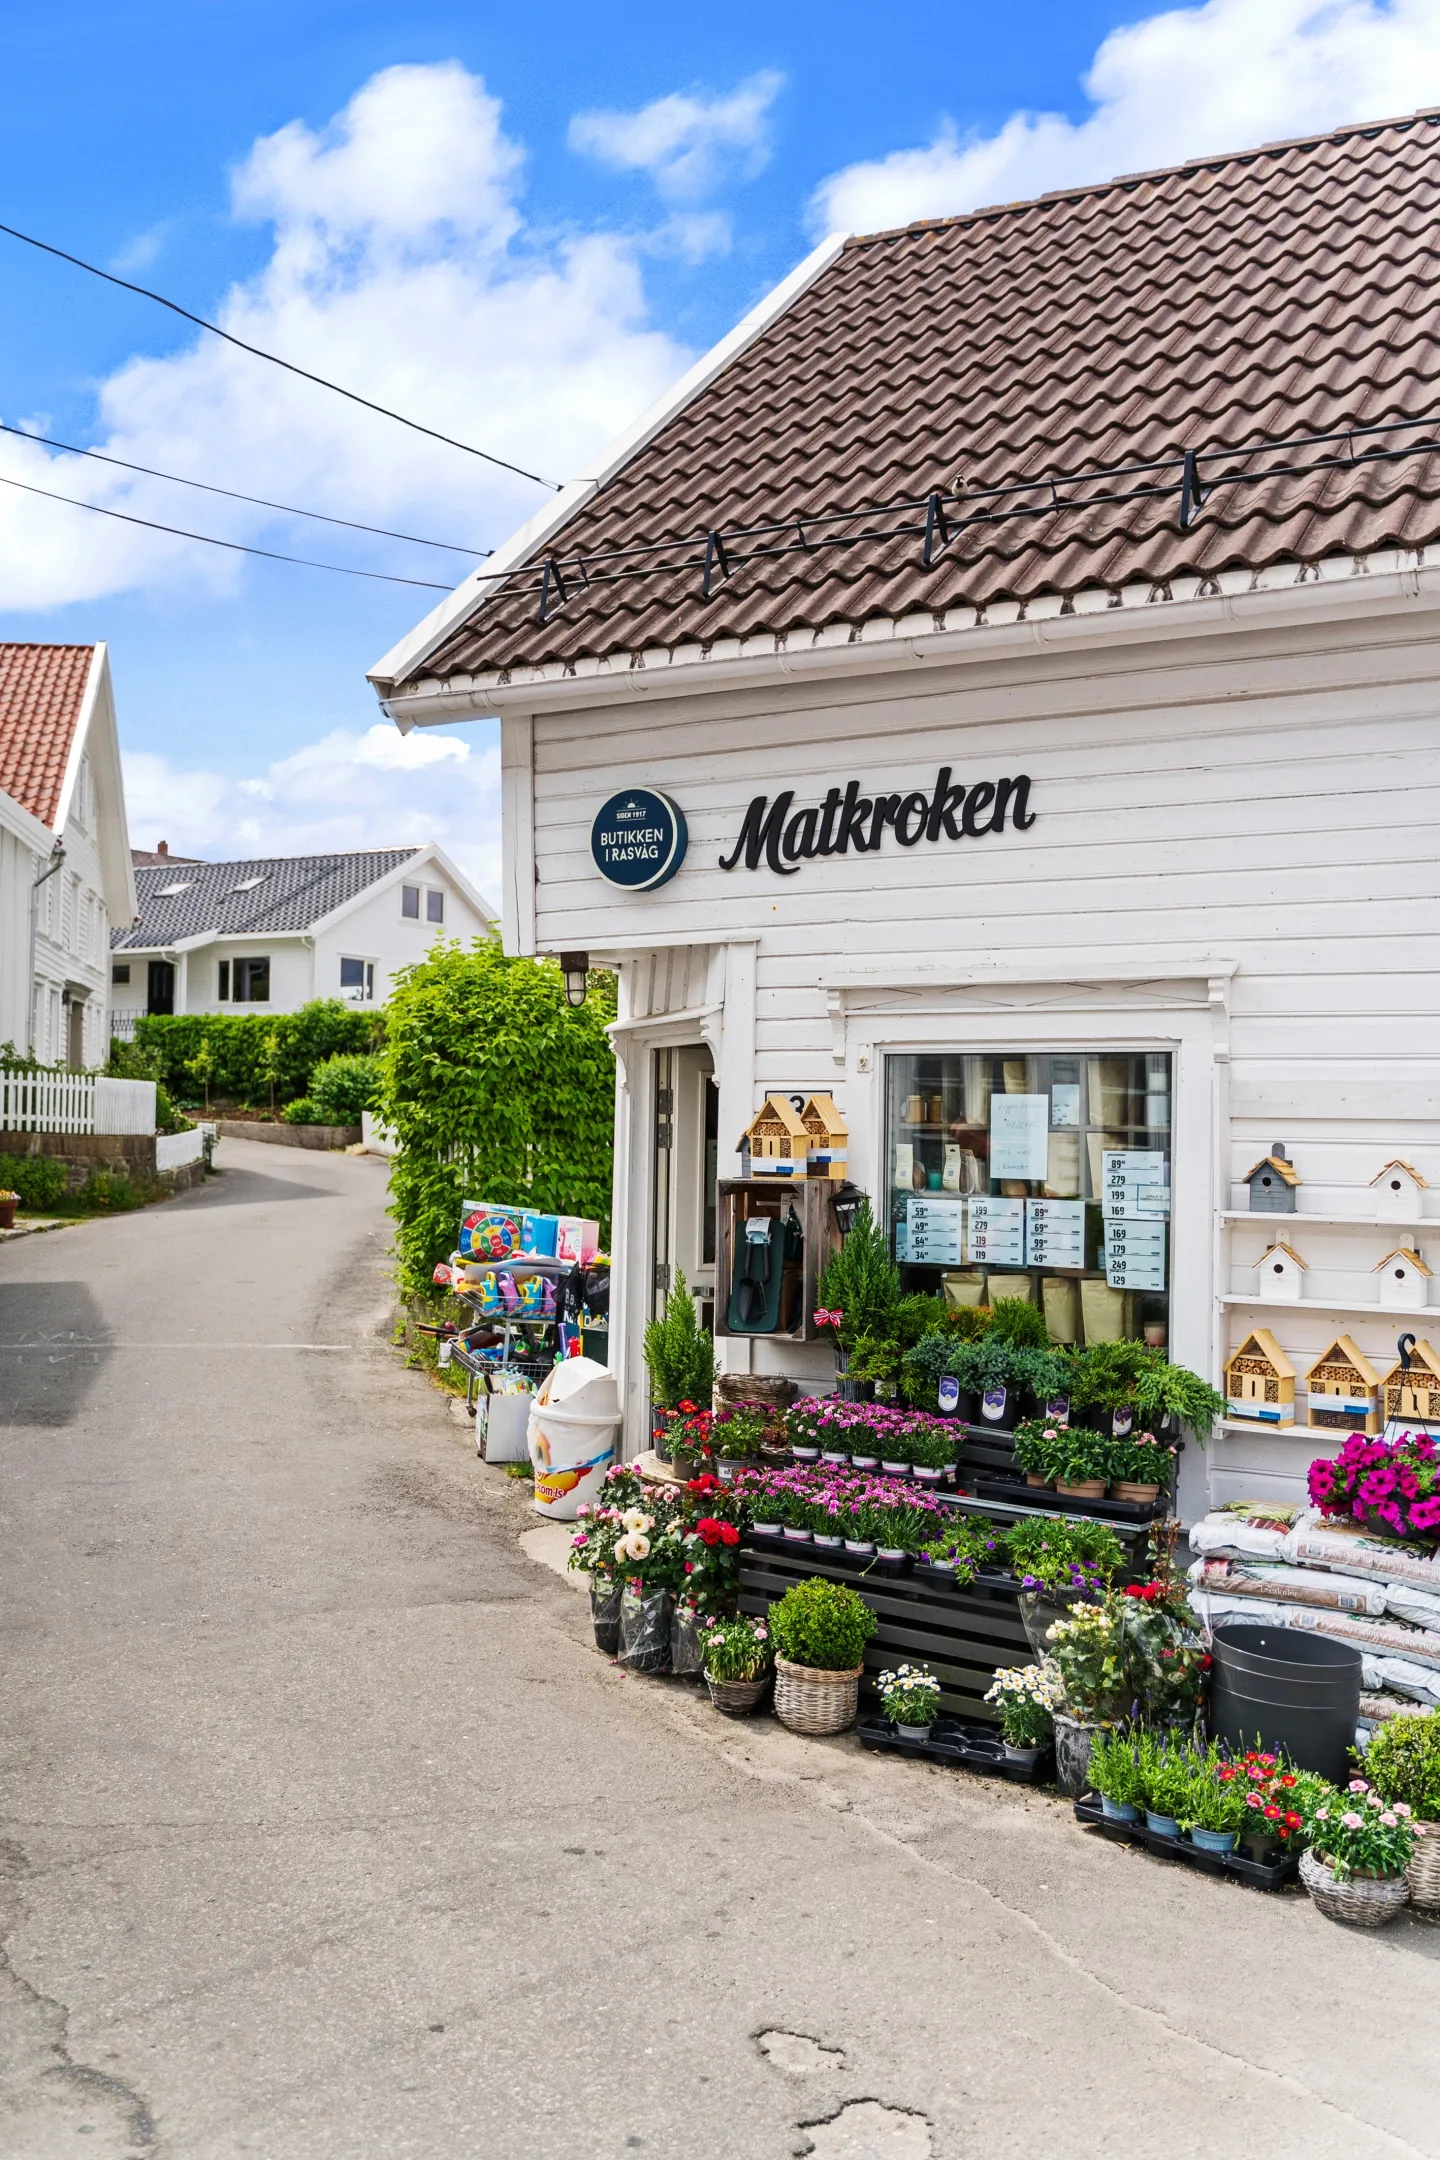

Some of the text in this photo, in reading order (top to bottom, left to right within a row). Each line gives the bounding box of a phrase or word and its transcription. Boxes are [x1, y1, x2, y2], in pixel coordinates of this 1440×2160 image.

[616, 810, 647, 819] SIDEN 1917
[719, 767, 1037, 875] Matkroken
[600, 828, 664, 846] BUTIKKEN
[605, 844, 659, 862] I RASVÅG
[1111, 1175, 1126, 1184] 279
[1111, 1190, 1125, 1200] 199
[975, 1205, 988, 1215] 199
[1111, 1206, 1125, 1215] 169
[974, 1220, 988, 1230] 279
[1112, 1229, 1126, 1239] 169
[975, 1235, 986, 1245] 119
[1112, 1244, 1126, 1254] 179
[975, 1250, 986, 1260] 119
[1112, 1260, 1127, 1270] 249
[1112, 1275, 1126, 1285] 129
